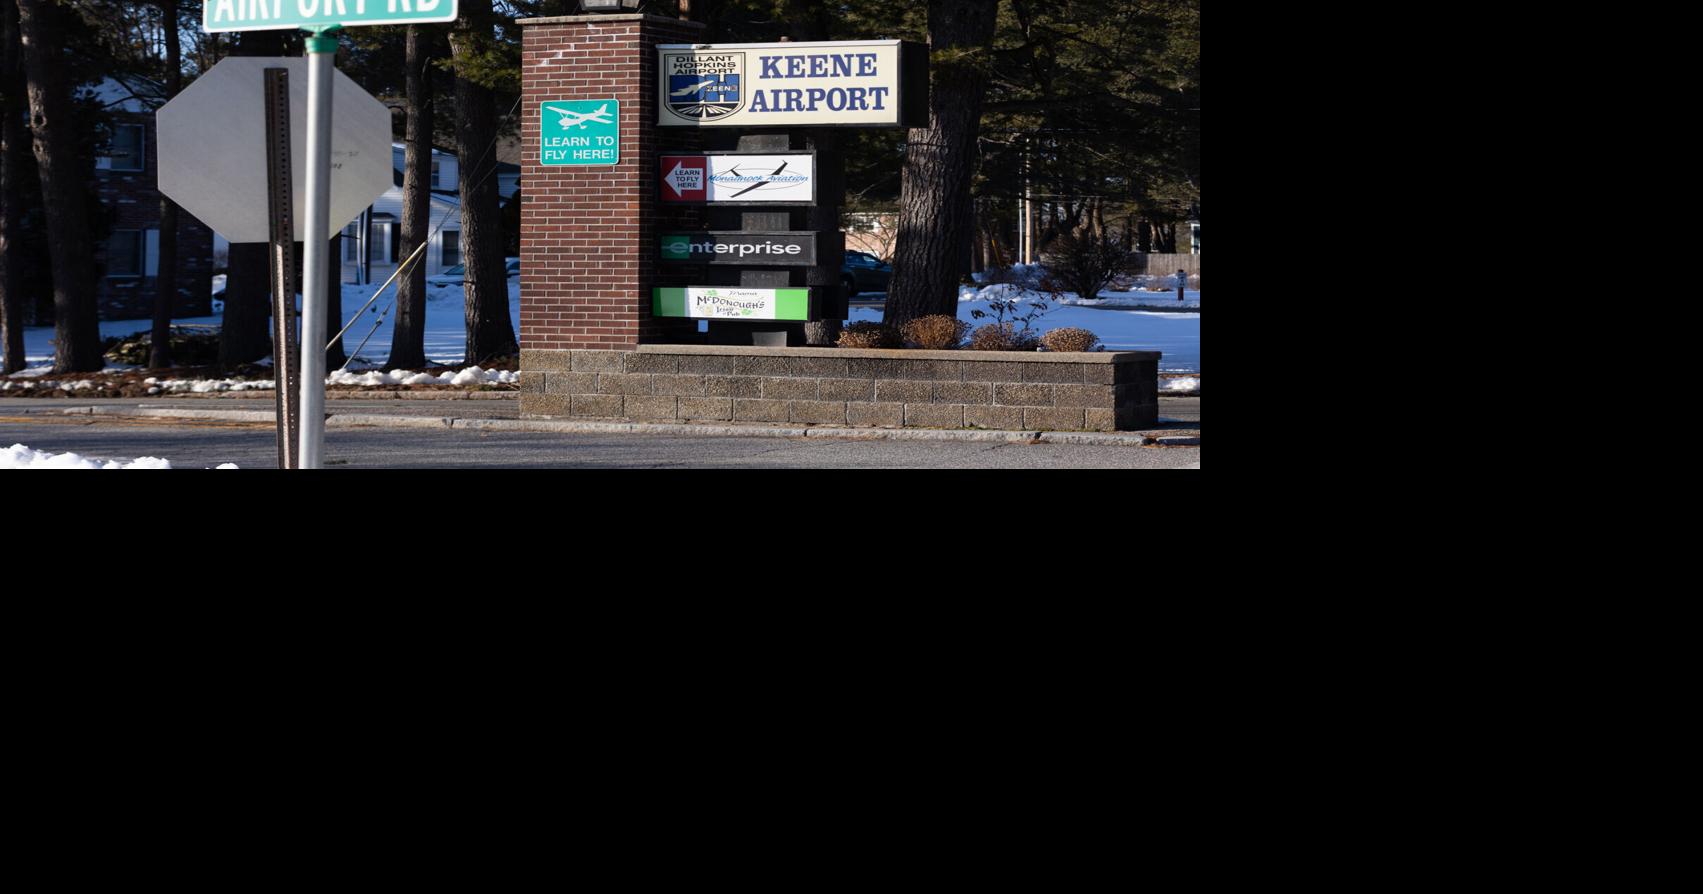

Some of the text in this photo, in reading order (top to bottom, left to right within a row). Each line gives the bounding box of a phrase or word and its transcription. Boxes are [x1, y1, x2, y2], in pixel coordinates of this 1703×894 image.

[759, 53, 877, 79] KEENE
[748, 87, 889, 112] AIRPORT
[544, 136, 615, 147] LEARN TO
[545, 149, 614, 160] FLY HERE!
[766, 174, 808, 183] Aviation
[663, 241, 802, 257] enterprise
